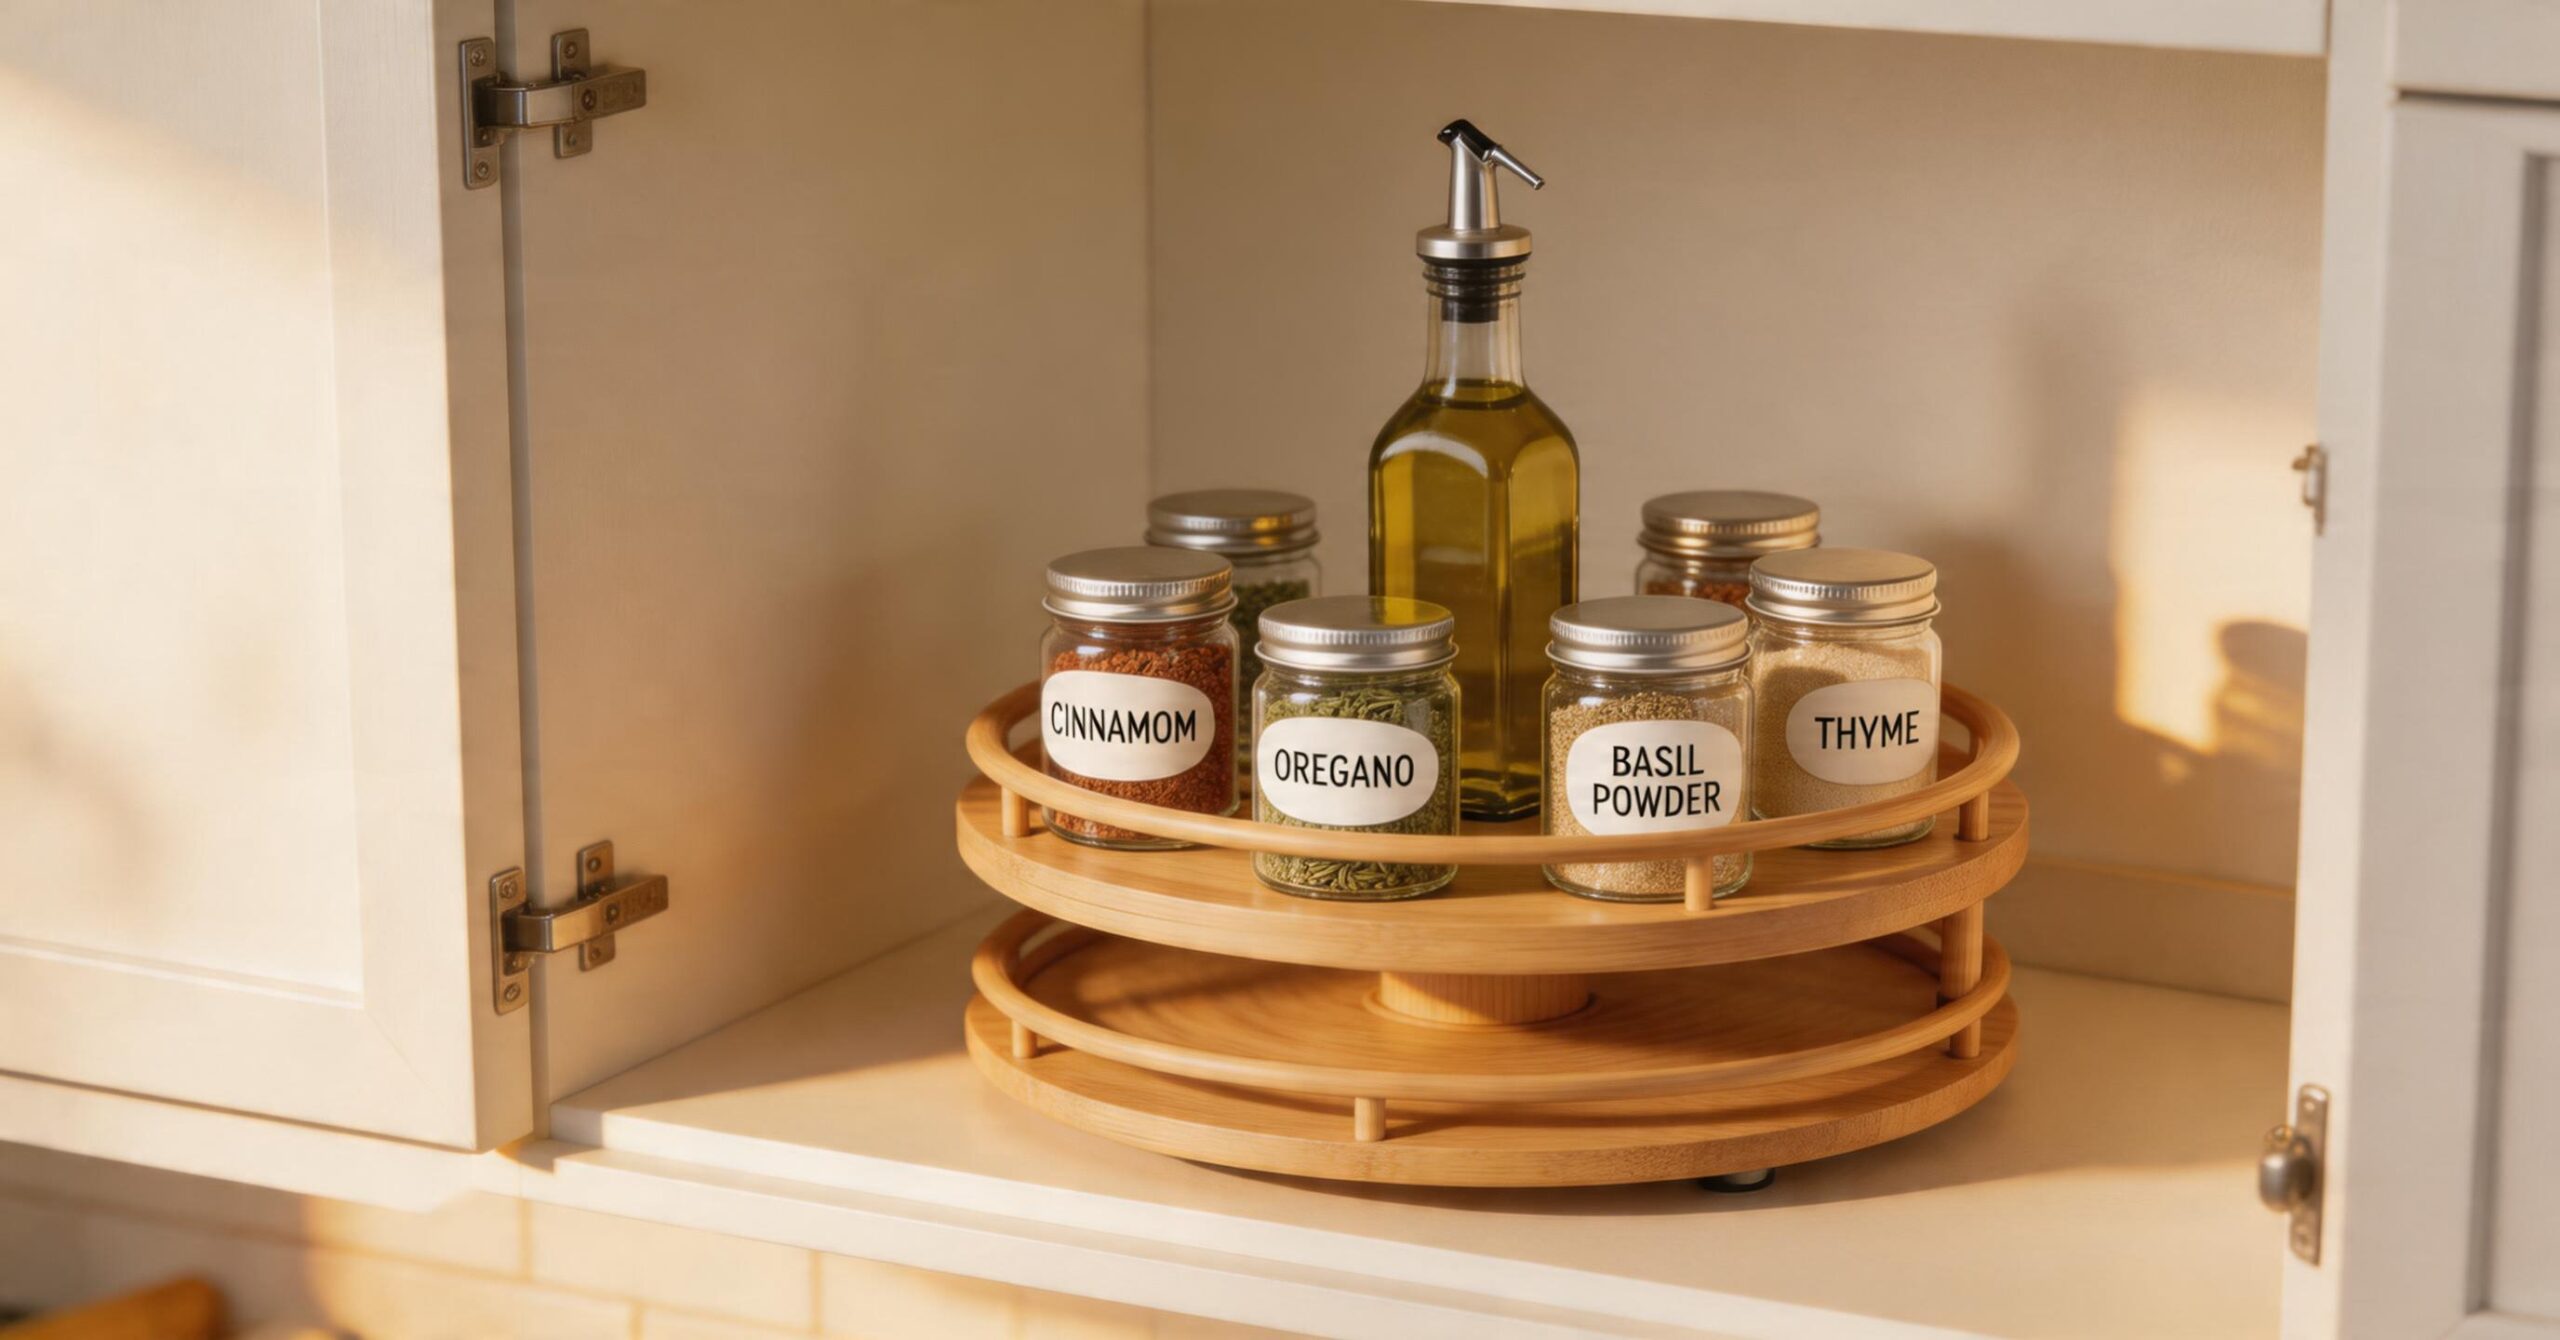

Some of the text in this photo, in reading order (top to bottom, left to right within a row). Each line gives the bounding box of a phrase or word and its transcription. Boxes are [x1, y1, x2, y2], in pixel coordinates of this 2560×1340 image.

[1050, 701, 1198, 745] CINNAMOM
[1813, 709, 1921, 751] THYME
[1274, 748, 1416, 789] OREGANO
[1592, 780, 1722, 819] POWDER
